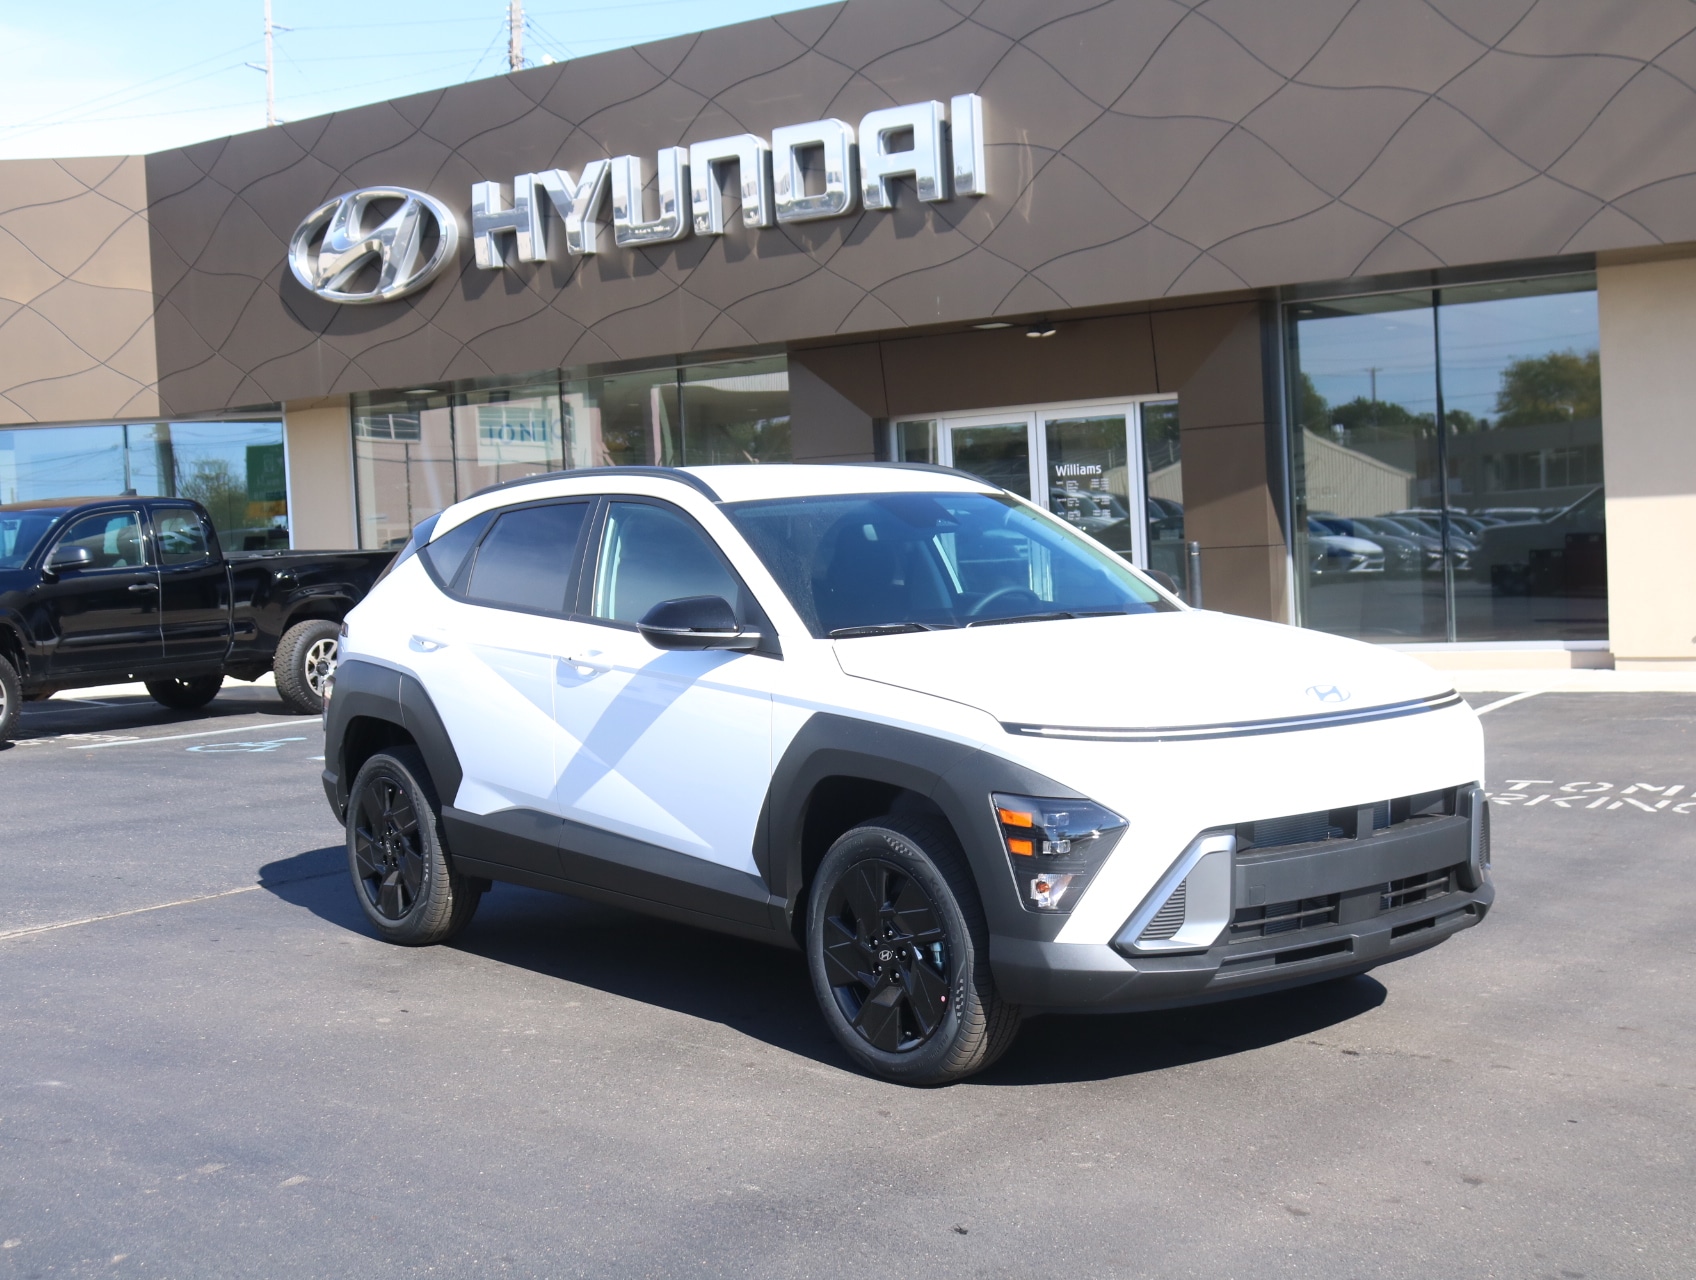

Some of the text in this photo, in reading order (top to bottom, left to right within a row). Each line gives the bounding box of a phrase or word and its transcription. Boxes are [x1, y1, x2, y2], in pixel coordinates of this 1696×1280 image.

[471, 93, 987, 270] HYUNDAI
[1055, 463, 1102, 477] Williams
[1505, 779, 1696, 798] TOM
